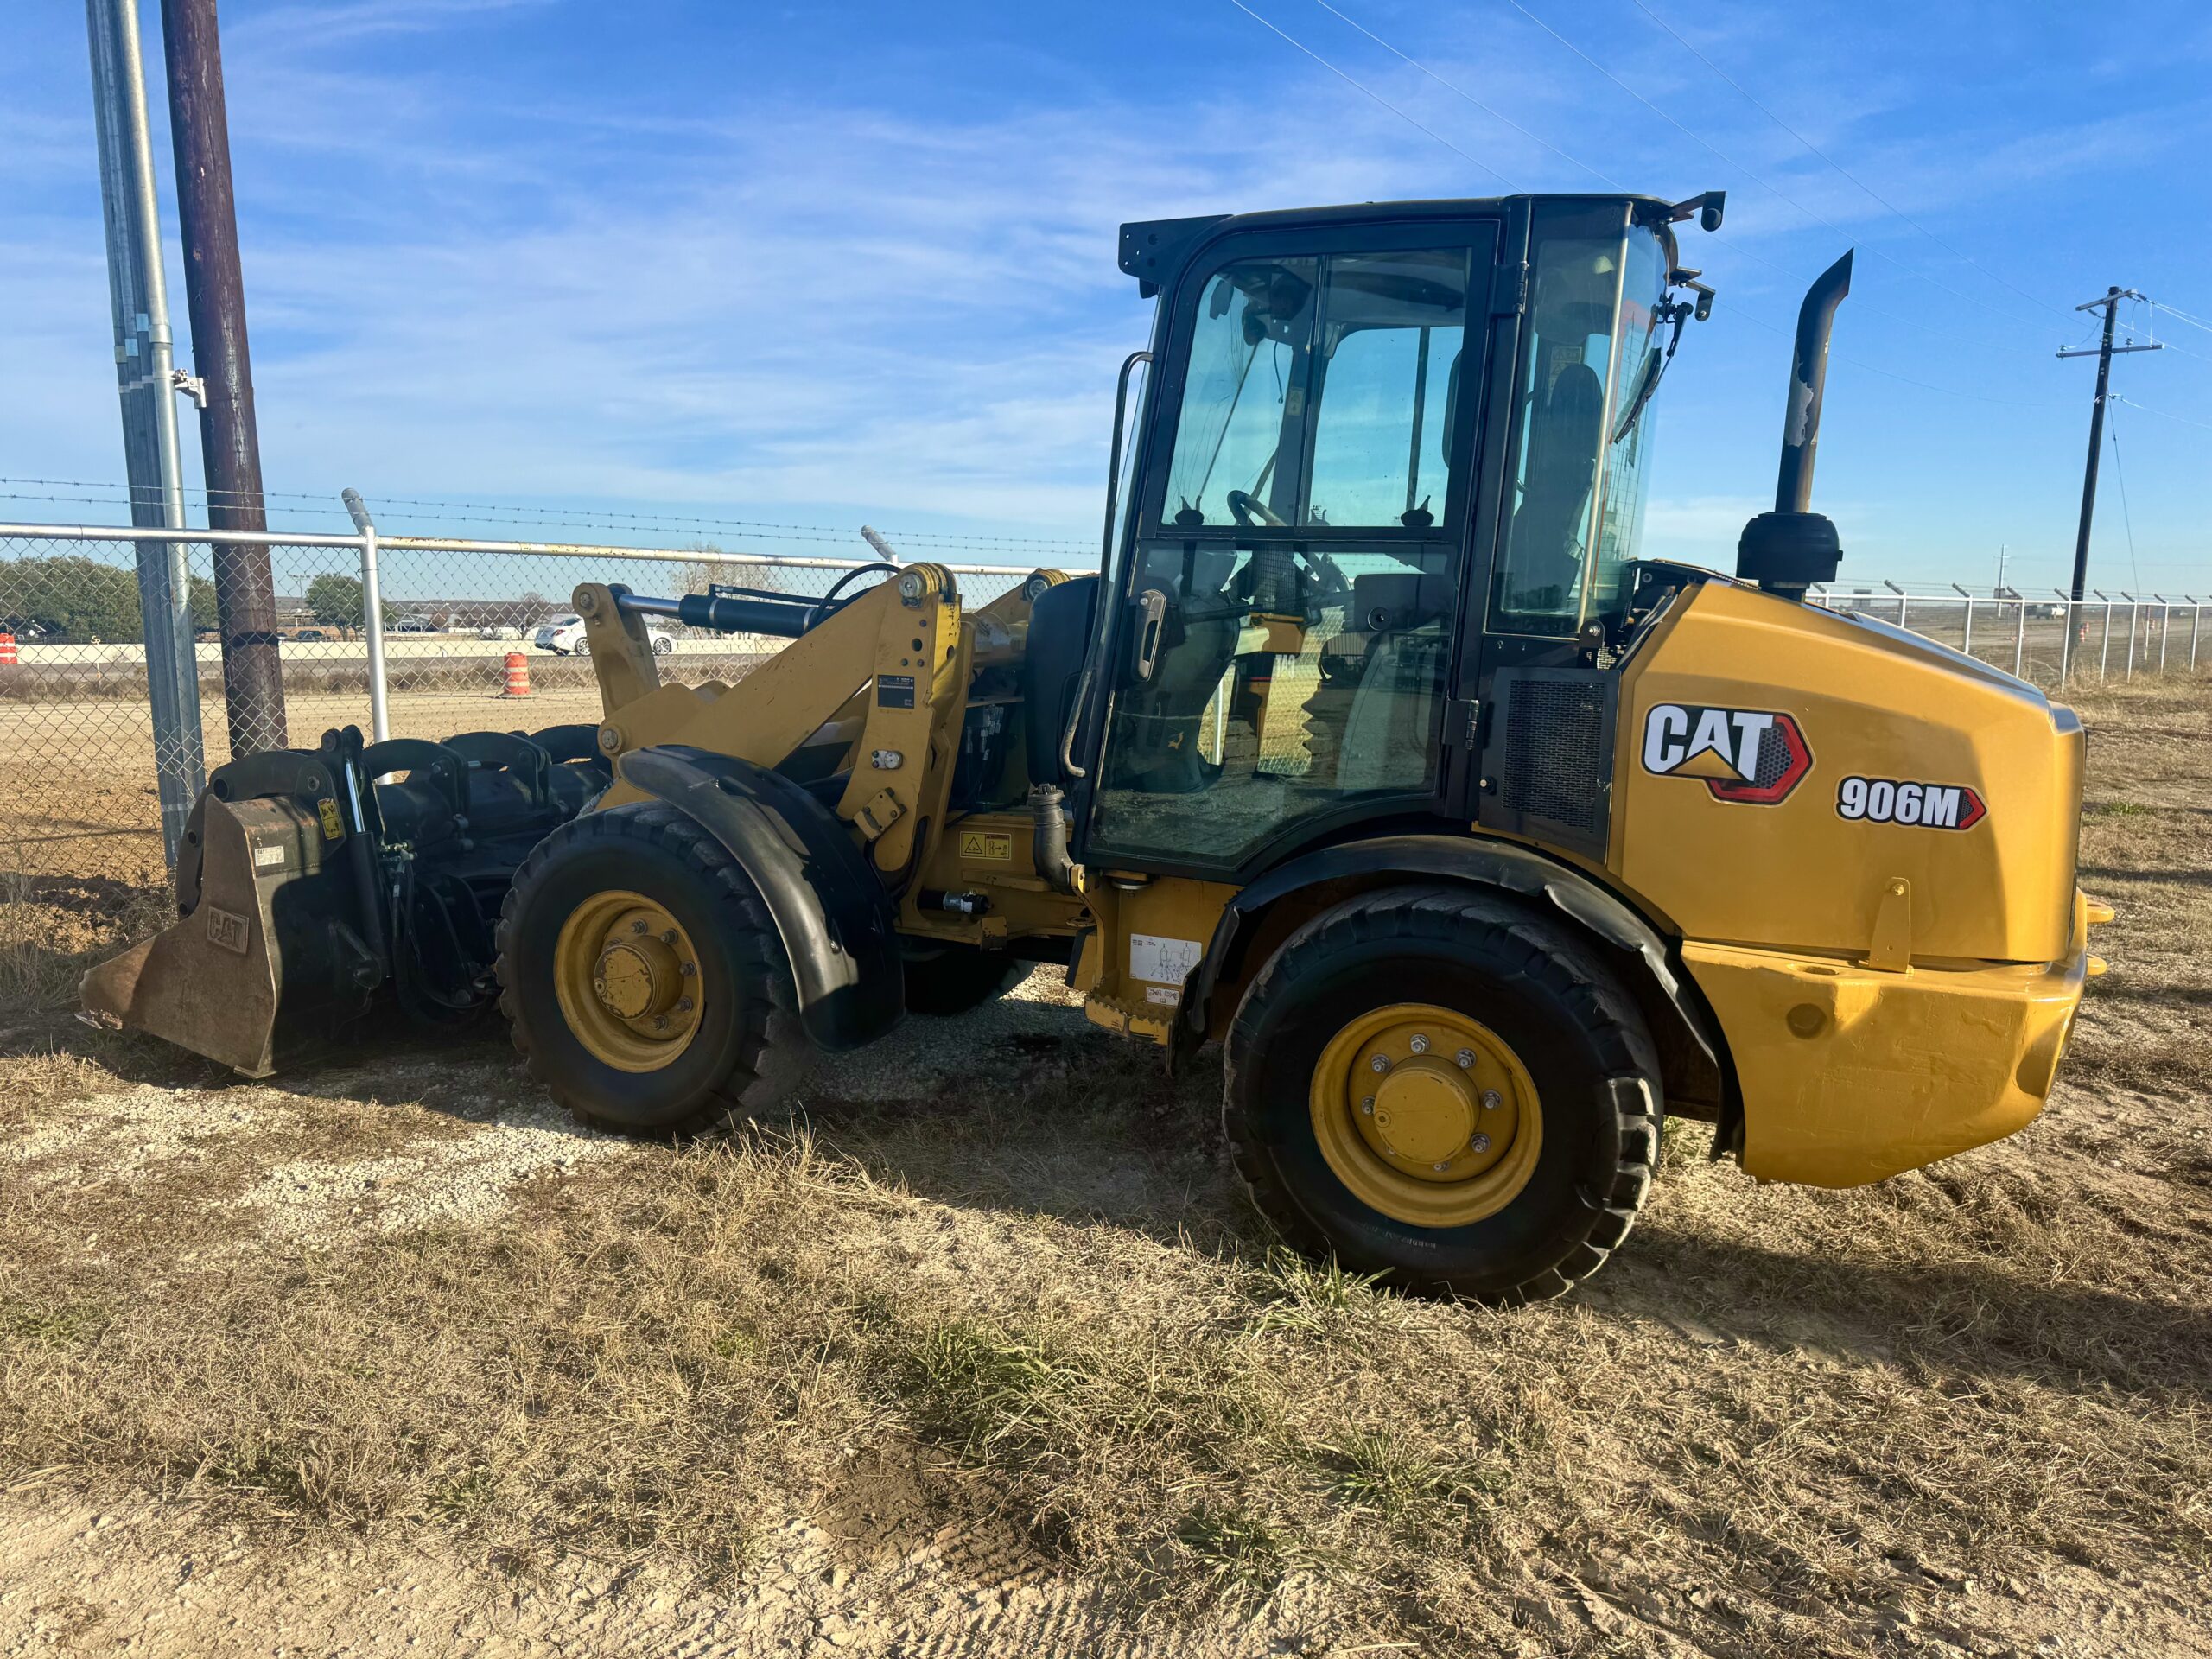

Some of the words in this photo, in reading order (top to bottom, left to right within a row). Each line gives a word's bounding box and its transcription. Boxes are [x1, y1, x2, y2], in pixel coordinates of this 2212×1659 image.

[1644, 705, 1773, 781] CAT
[1840, 779, 1961, 827] 906M
[210, 912, 245, 950] CAT
